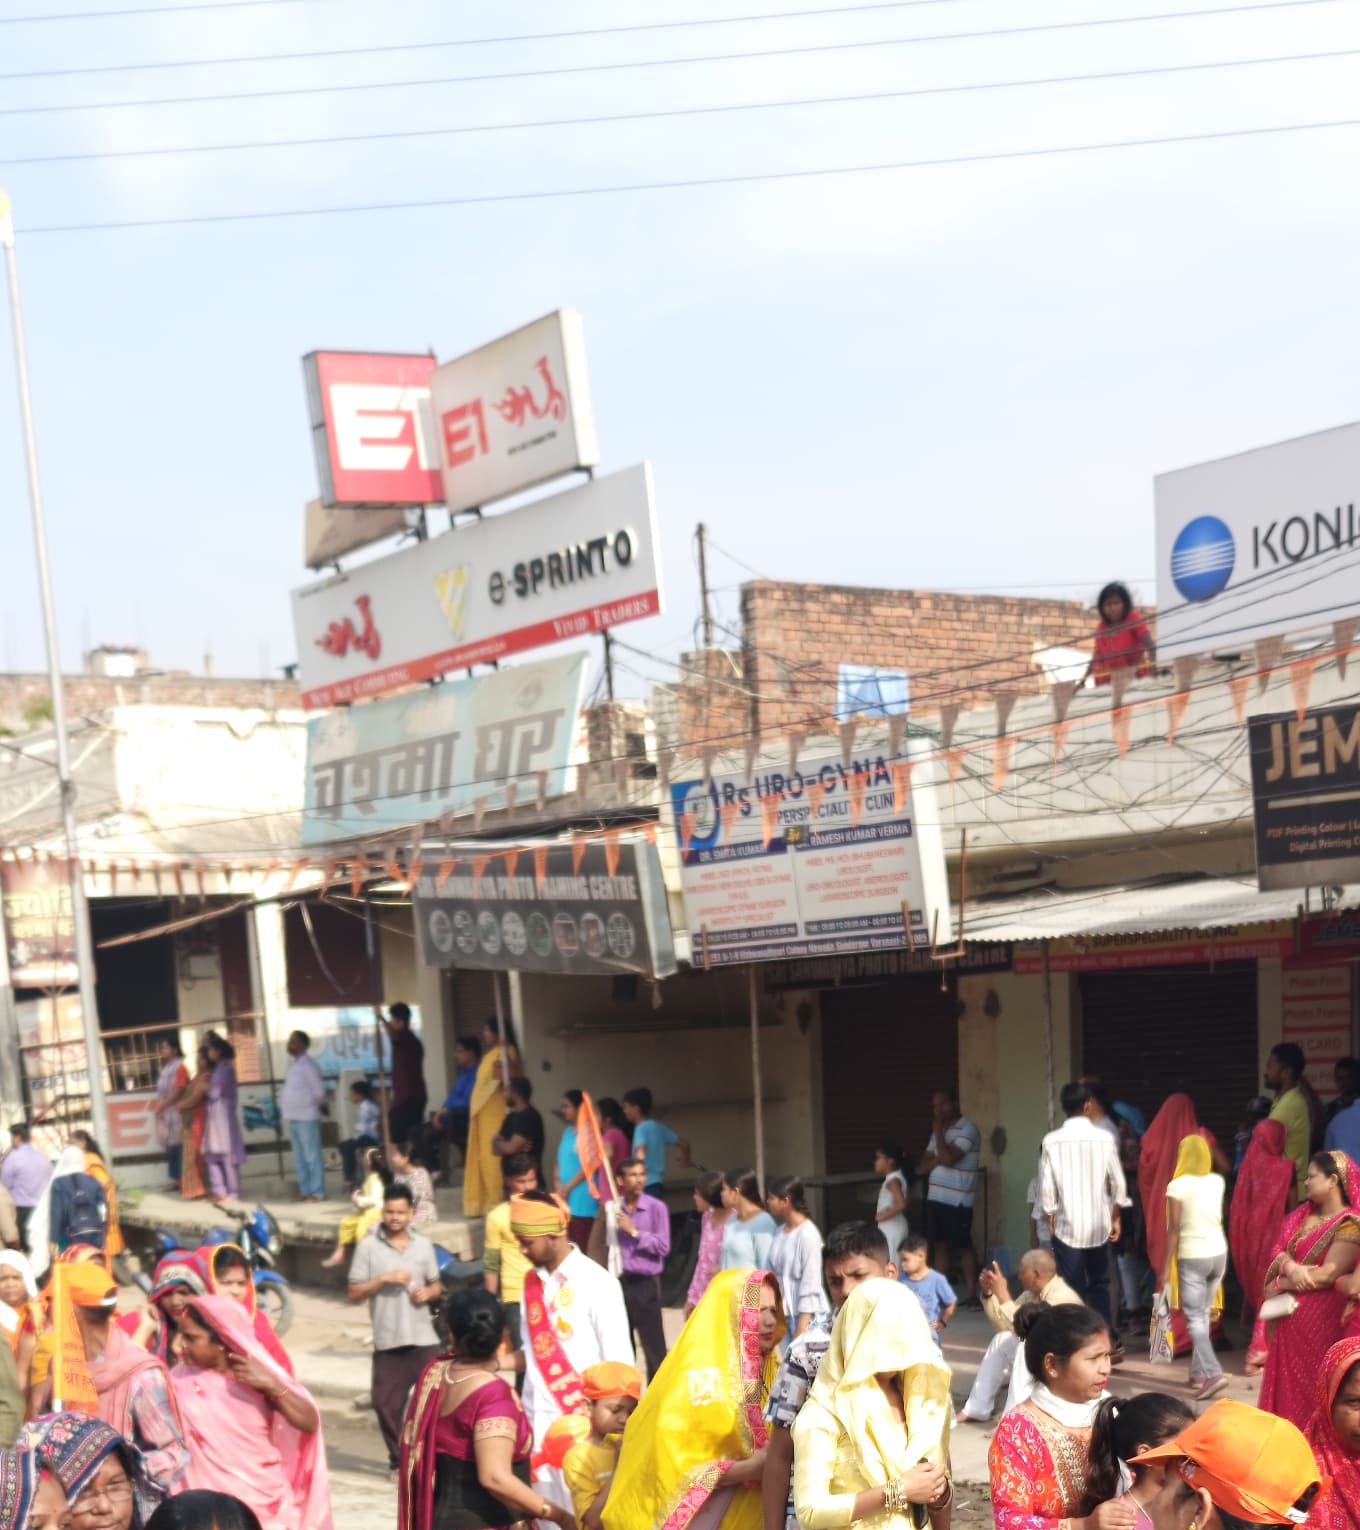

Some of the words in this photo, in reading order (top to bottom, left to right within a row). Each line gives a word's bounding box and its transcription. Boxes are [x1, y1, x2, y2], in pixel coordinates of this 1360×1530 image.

[474, 707, 566, 788] घर
[844, 826, 877, 841] KUMAR
[877, 821, 909, 836] VERMA
[1319, 837, 1352, 851] Printing
[590, 876, 638, 899] CENTRE
